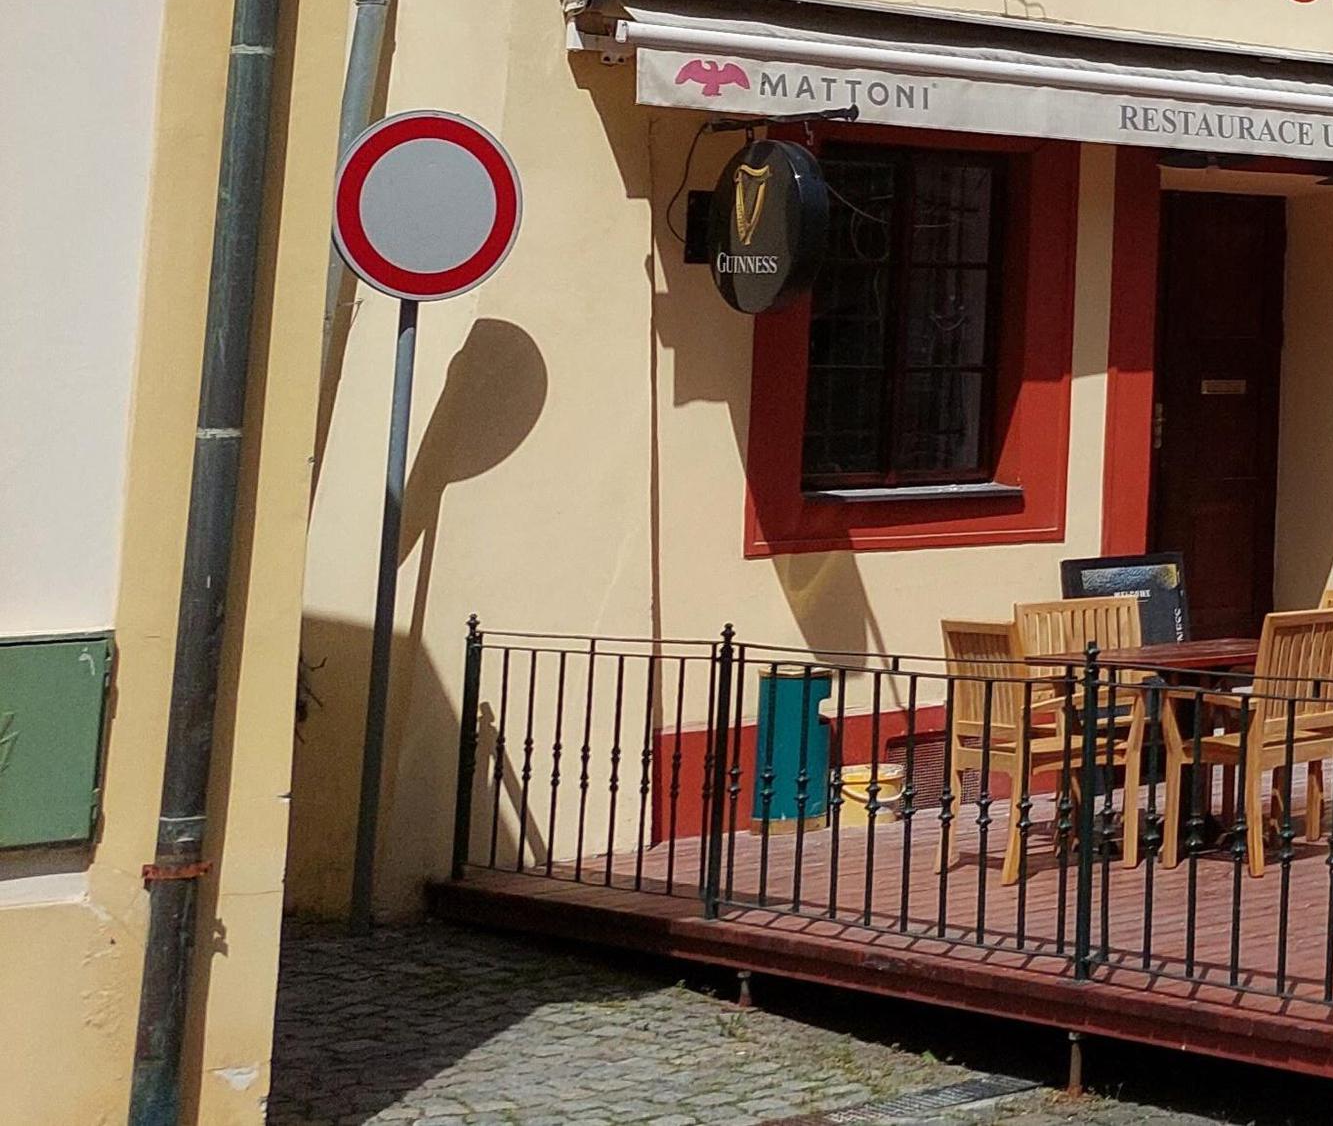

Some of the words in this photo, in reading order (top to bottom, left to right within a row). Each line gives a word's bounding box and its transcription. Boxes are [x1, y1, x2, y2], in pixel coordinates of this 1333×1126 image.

[759, 72, 930, 110] MATTONI
[1119, 103, 1314, 147] RESTAURACE
[717, 252, 778, 274] GUINNESS
